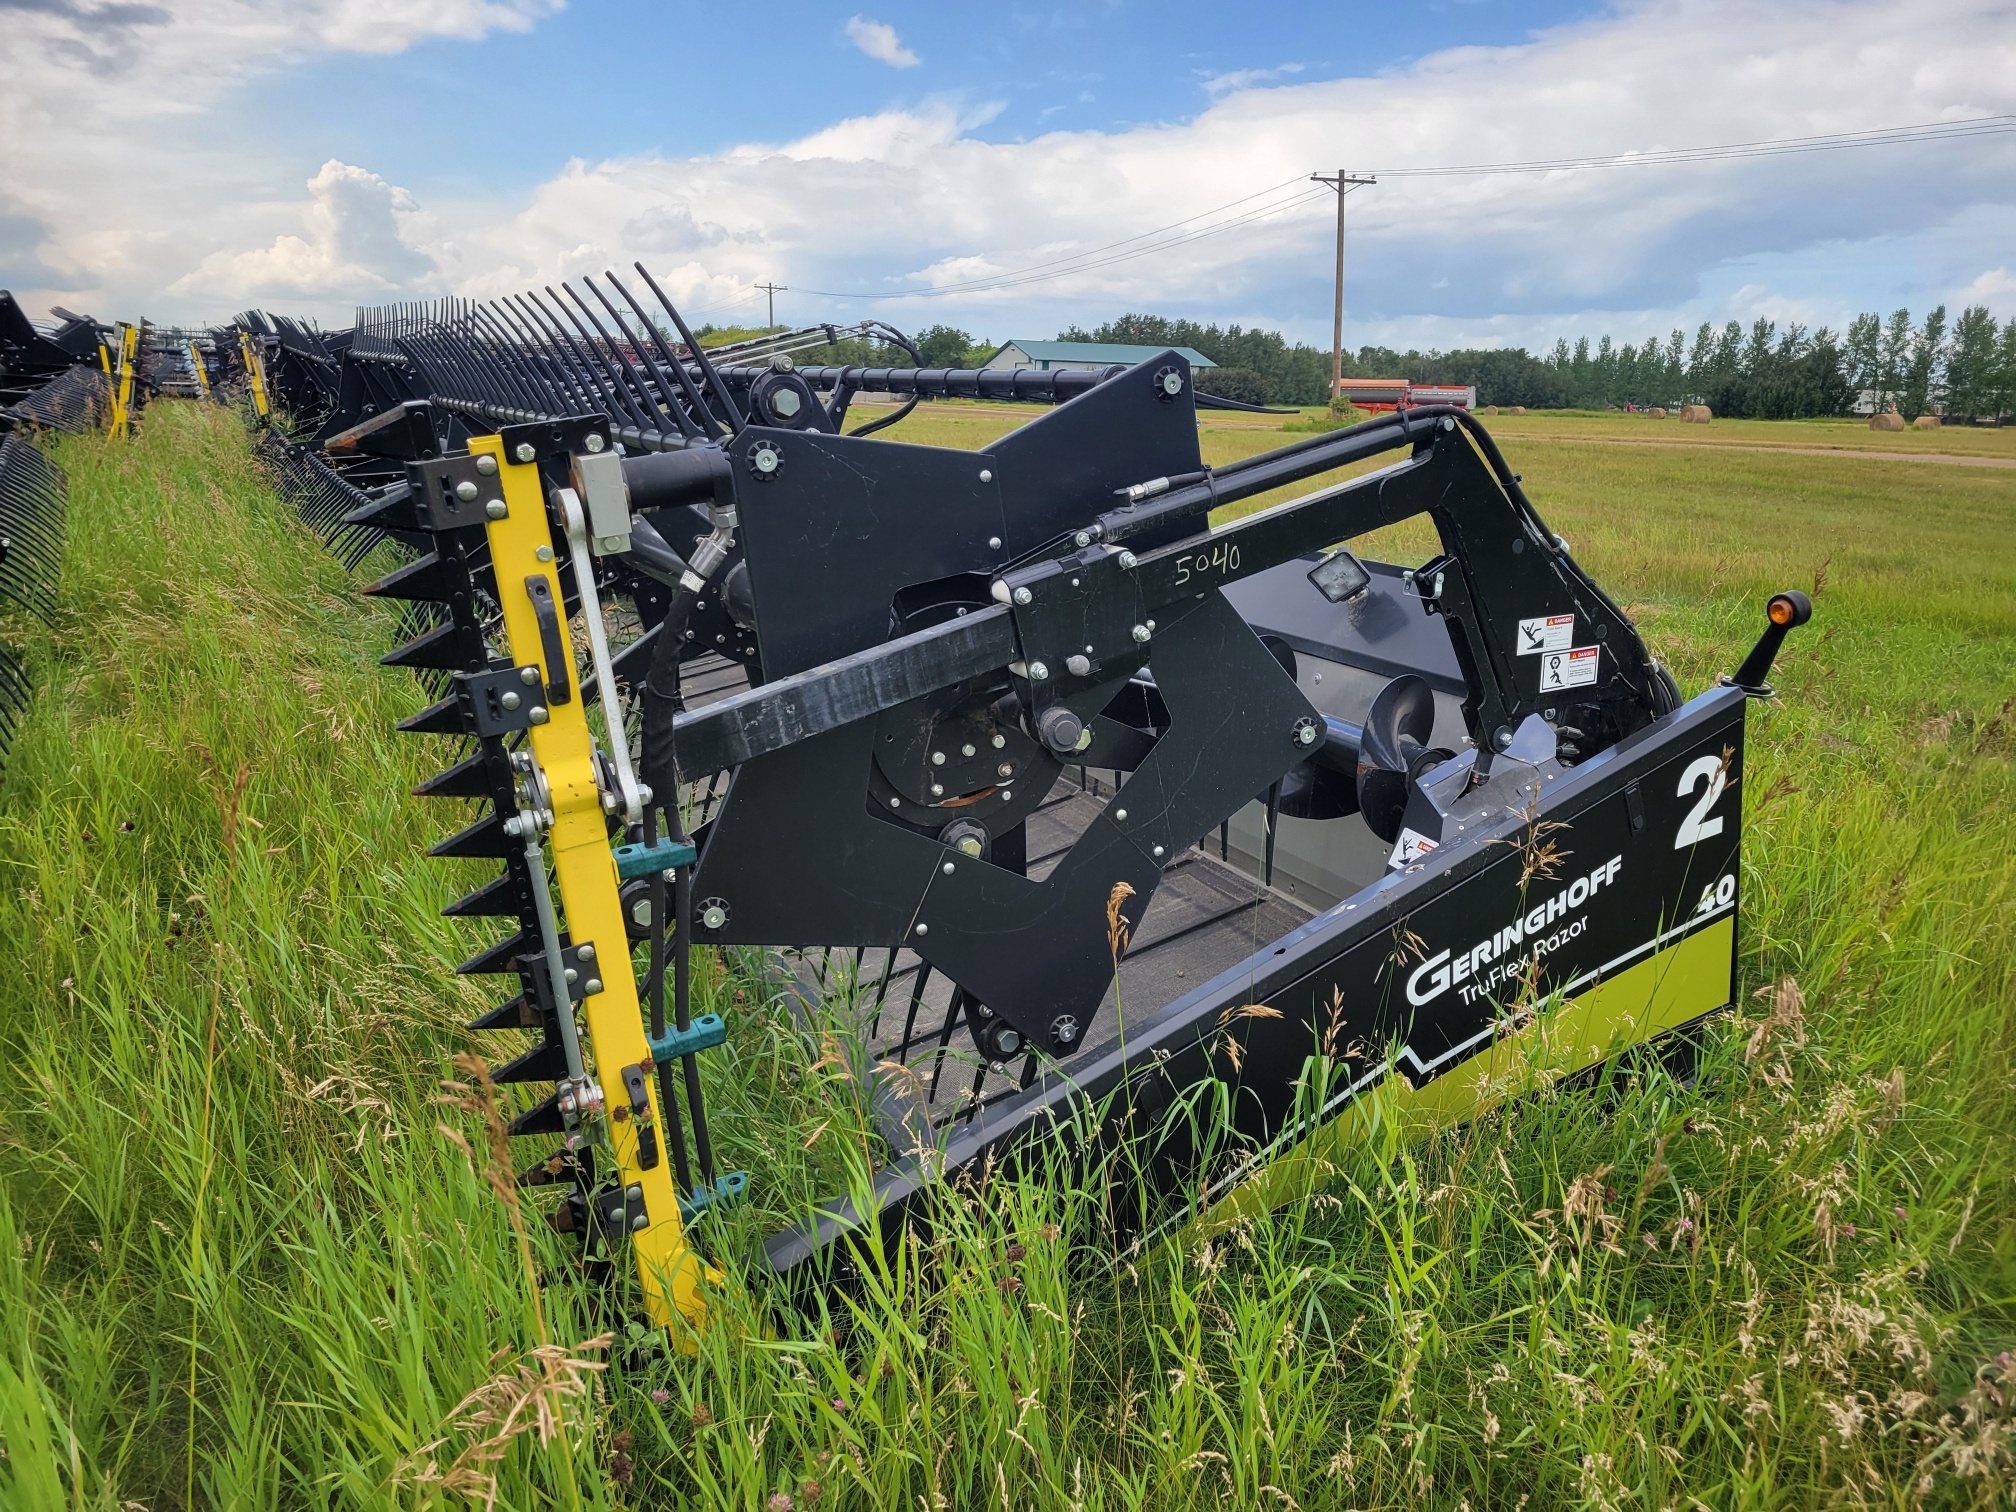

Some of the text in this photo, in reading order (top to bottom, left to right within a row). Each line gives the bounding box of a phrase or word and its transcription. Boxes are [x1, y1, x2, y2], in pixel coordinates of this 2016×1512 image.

[1175, 542, 1241, 585] 5040
[1554, 616, 1572, 624] DANGER
[1577, 650, 1595, 658] DANGER
[1674, 755, 1726, 850] 2
[1697, 873, 1736, 913] 40
[1458, 915, 1588, 1006] TruFlex Razor
